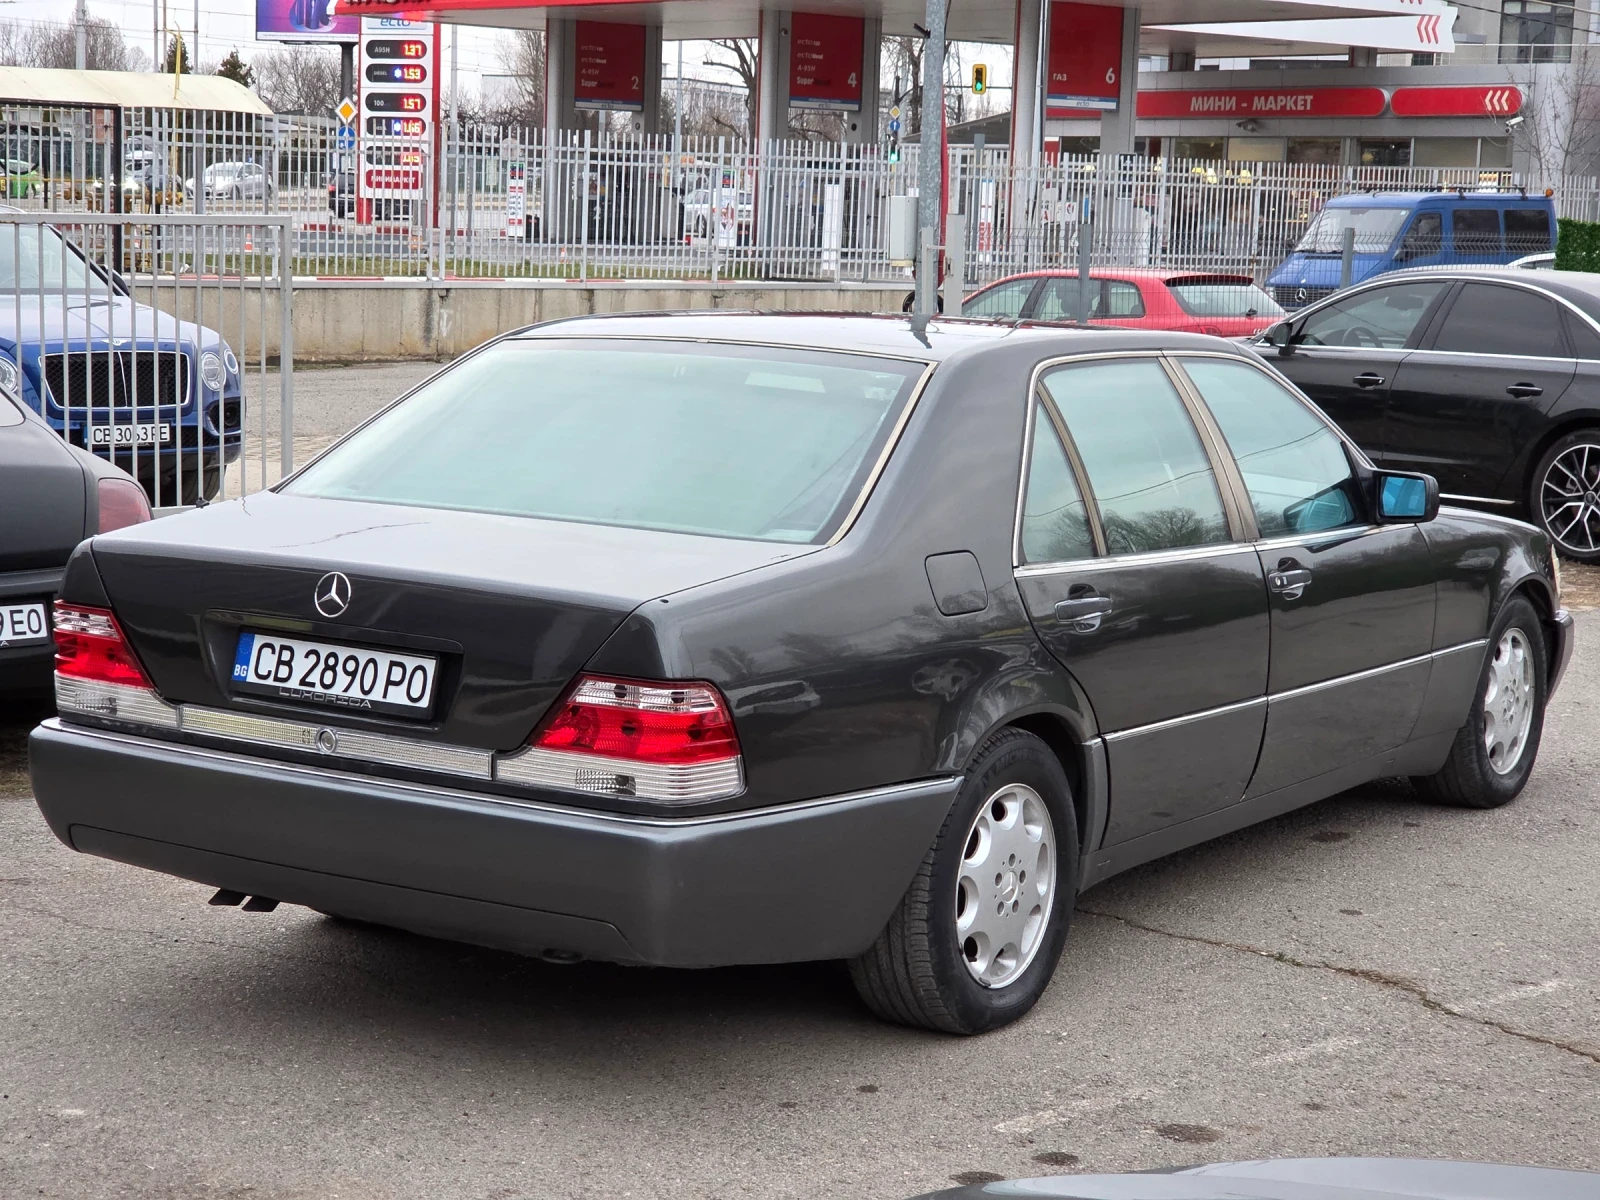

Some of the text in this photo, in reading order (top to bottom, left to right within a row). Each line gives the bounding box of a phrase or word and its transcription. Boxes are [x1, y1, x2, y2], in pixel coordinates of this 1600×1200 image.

[631, 76, 639, 89] 2
[797, 76, 814, 85] Super
[847, 72, 857, 88] 4
[1053, 73, 1068, 81] ГАЗ
[1105, 67, 1116, 84] 6
[1190, 96, 1236, 112] МИНИ
[1253, 95, 1314, 111] МАРКЕТ
[9, 608, 42, 636] EO
[233, 642, 428, 704] BG CB 2890 PO
